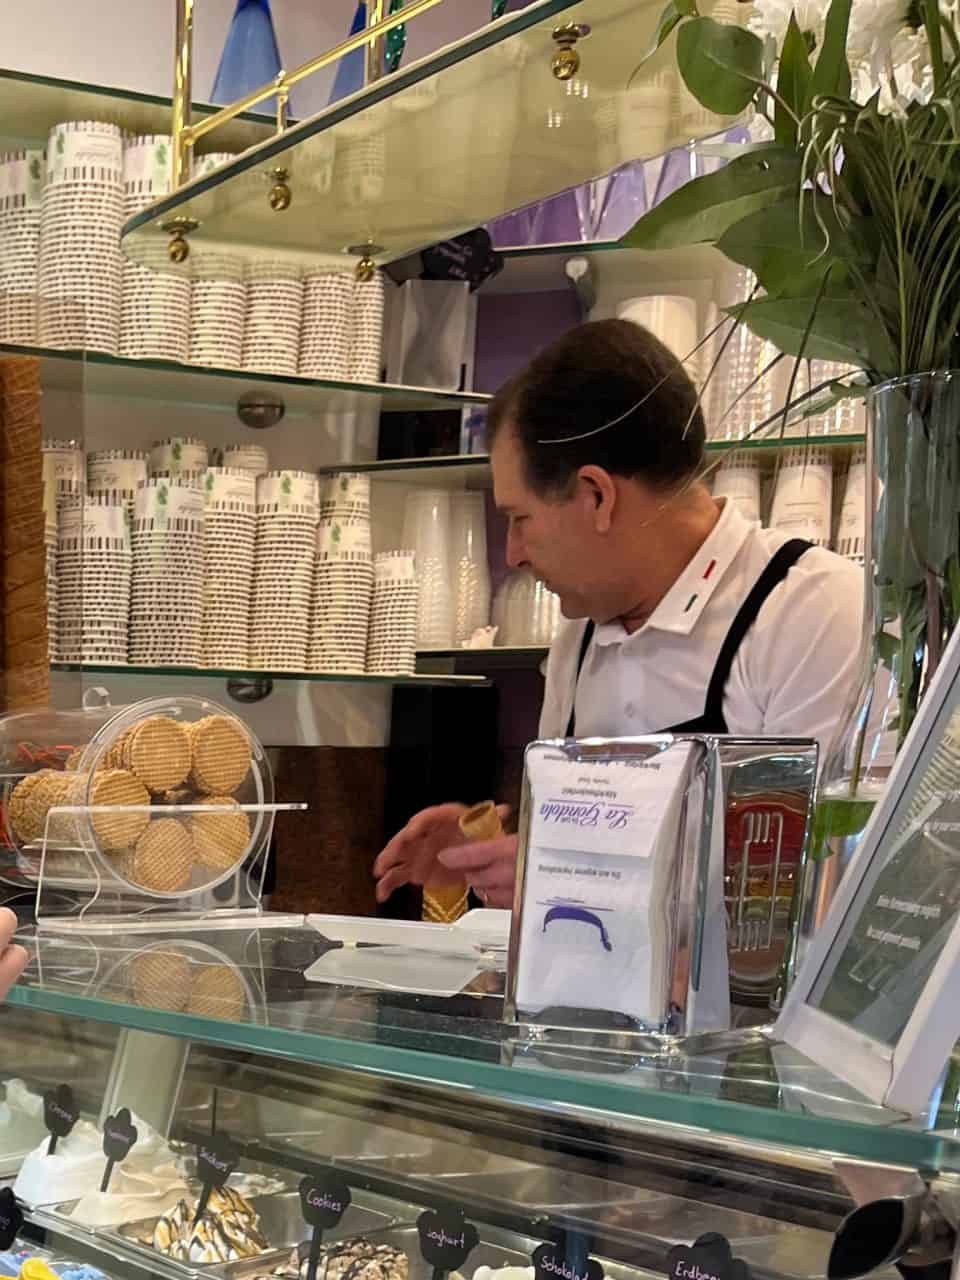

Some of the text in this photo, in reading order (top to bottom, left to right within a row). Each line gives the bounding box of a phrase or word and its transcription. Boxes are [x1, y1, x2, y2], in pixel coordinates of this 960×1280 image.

[539, 801, 634, 829] La Gondola
[306, 1187, 342, 1212] Cookies
